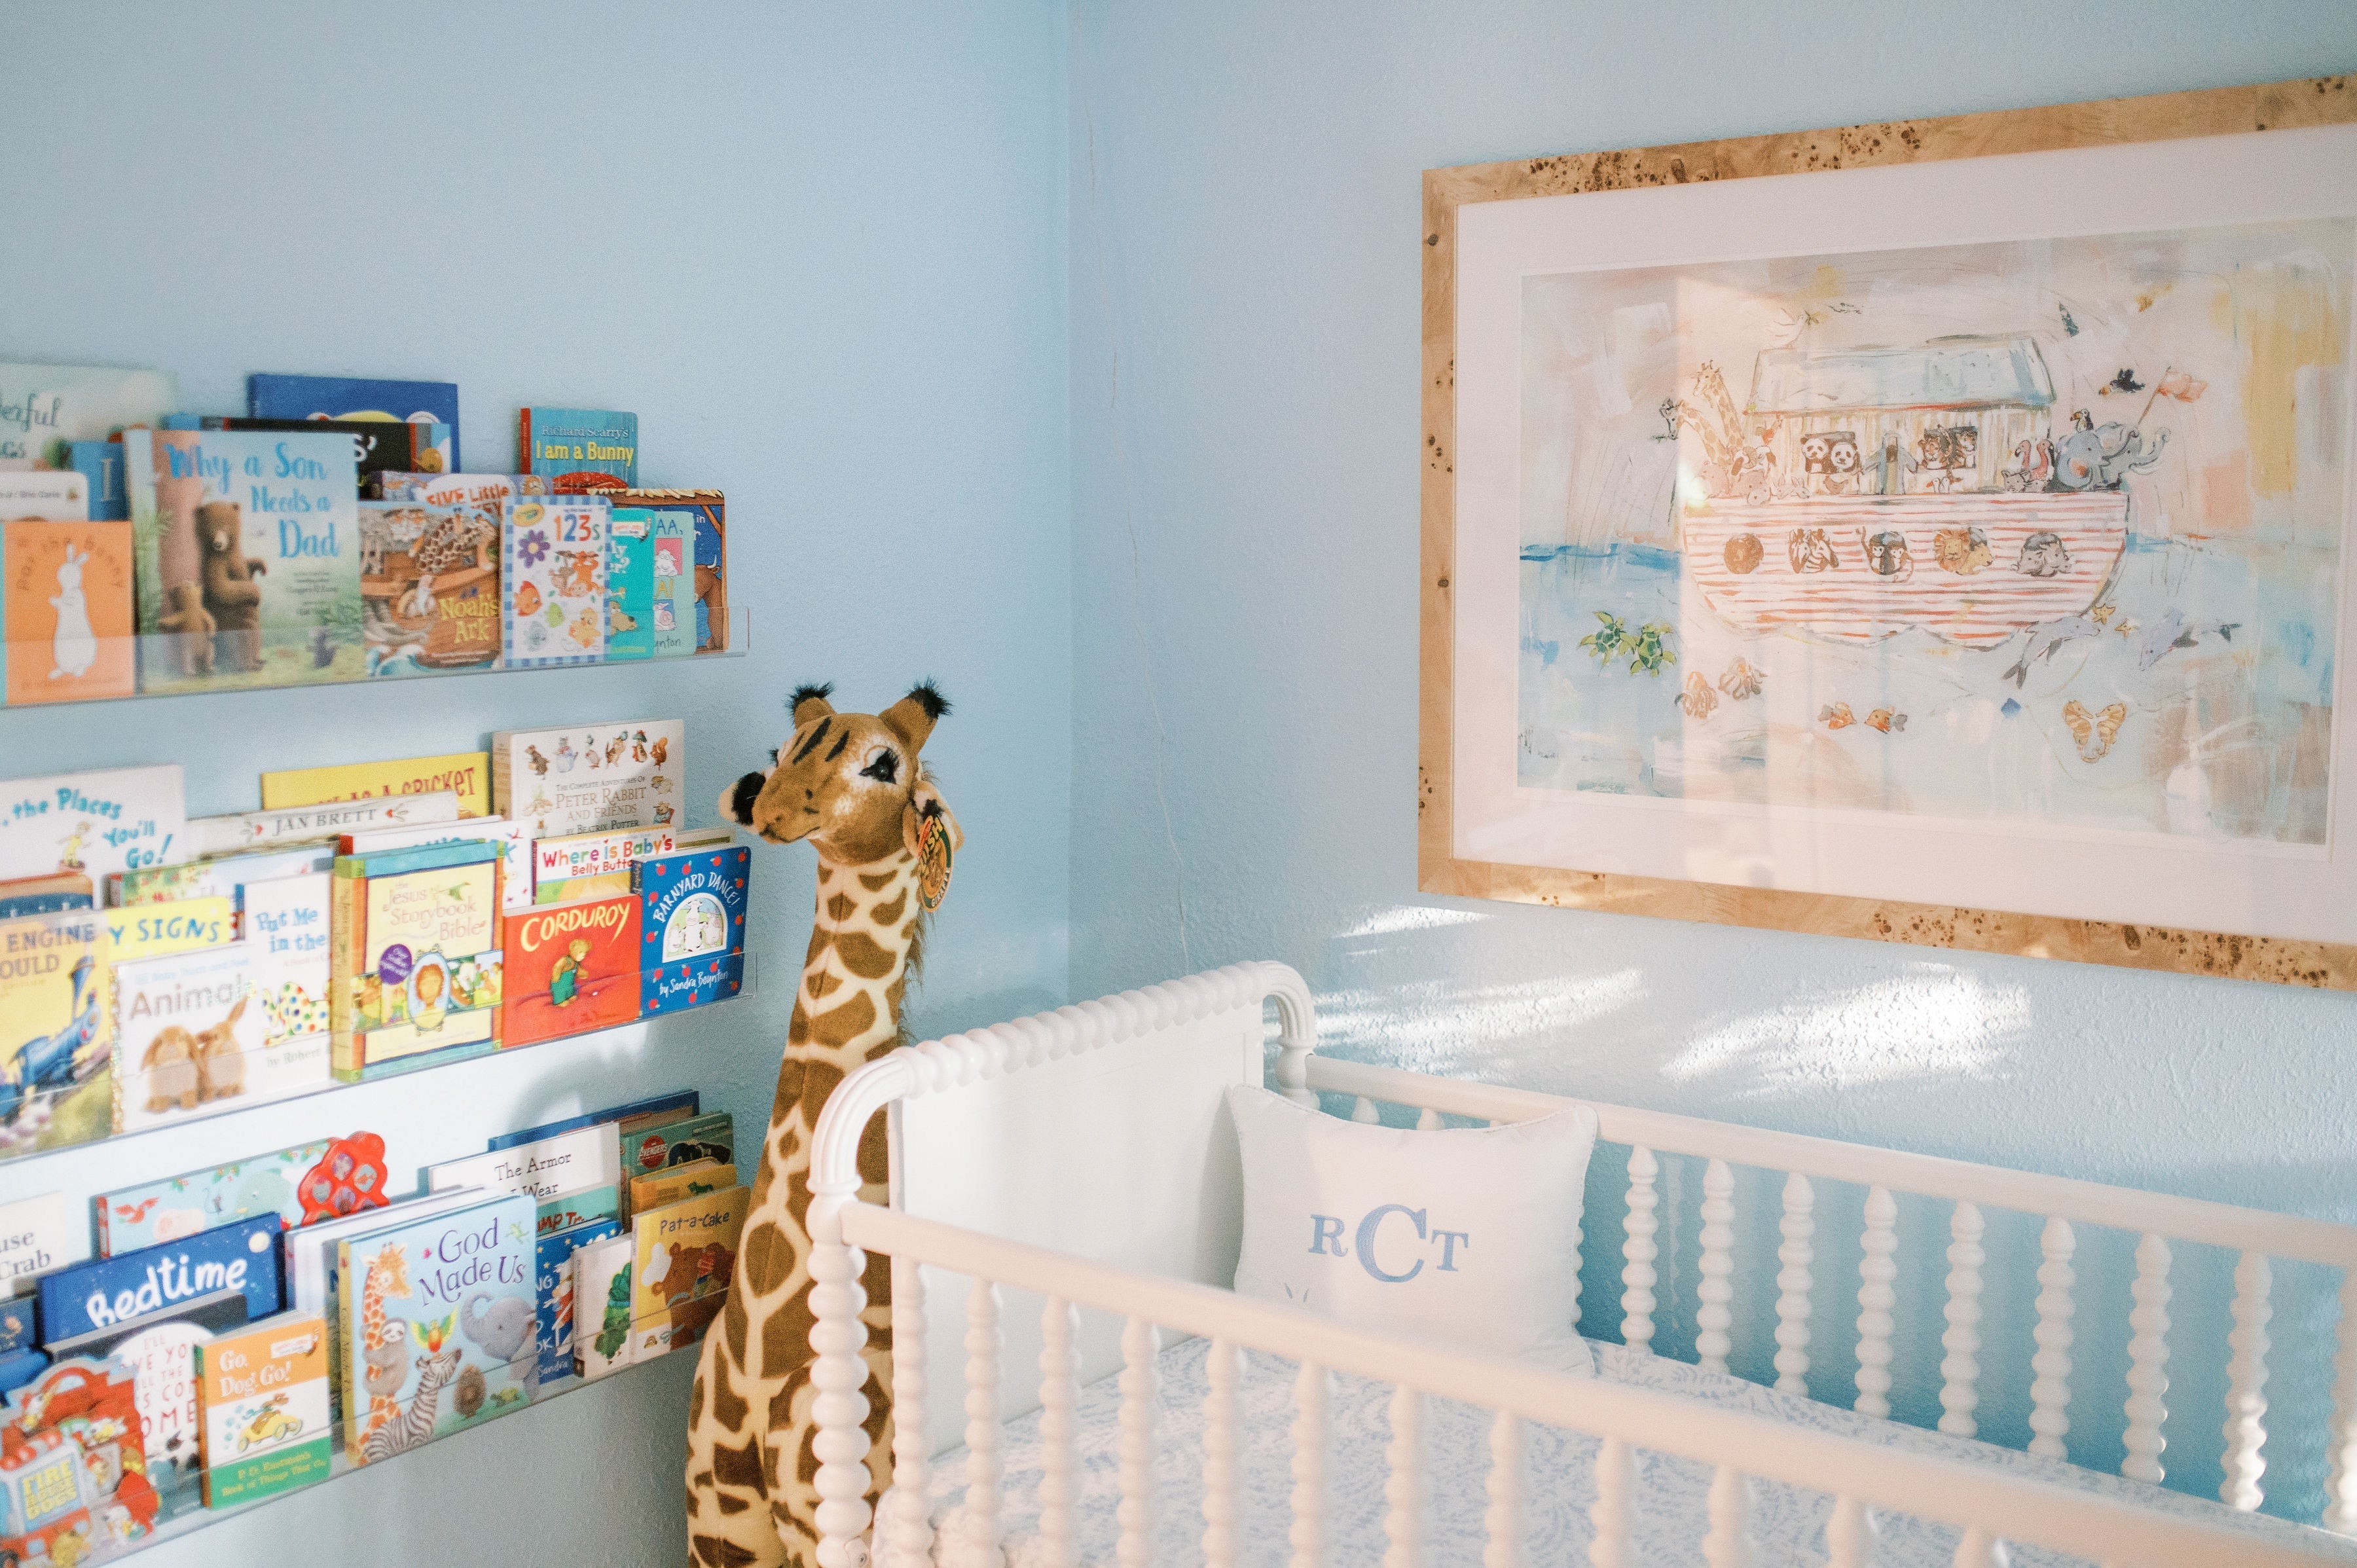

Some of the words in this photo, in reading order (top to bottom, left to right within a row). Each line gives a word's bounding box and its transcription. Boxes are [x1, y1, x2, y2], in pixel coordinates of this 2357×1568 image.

[542, 426, 585, 437] Richard
[588, 427, 629, 439] Scarry's
[536, 440, 541, 459] I
[545, 445, 569, 460] am
[574, 446, 583, 460] a
[587, 441, 634, 467] Bunny
[163, 443, 230, 494] Why
[244, 455, 261, 477] a
[274, 441, 327, 480] Son
[250, 485, 310, 513] Needs
[316, 496, 330, 511] a
[278, 519, 340, 558] Dad
[454, 619, 489, 643] Ark
[12, 799, 48, 818] the
[56, 788, 122, 820] Places
[556, 792, 598, 809] PETER
[602, 787, 647, 806] RABBIT
[272, 816, 307, 837] JAN
[316, 809, 377, 827] BRETT
[568, 811, 589, 821] AND
[594, 804, 638, 819] FRIENDS
[610, 819, 639, 830] POTTER
[101, 820, 155, 848] You'll
[126, 833, 173, 869] Go!
[543, 848, 600, 868] Where
[604, 839, 617, 860] is
[623, 833, 672, 858] Baby's
[571, 863, 598, 877] Belly
[602, 858, 633, 872] Butto
[383, 888, 427, 911] Jesus
[653, 873, 705, 923] BARNYARD
[708, 871, 740, 908] DANCE!
[255, 910, 287, 932] Put
[291, 907, 318, 926] Me
[390, 896, 477, 930] Storybook
[6, 923, 96, 953] ENGINE
[137, 916, 221, 942] SIGNS
[439, 917, 486, 941] Bible
[521, 902, 630, 953] CORDUROY
[269, 934, 289, 953] in
[295, 934, 326, 951] the
[659, 983, 669, 998] by
[670, 976, 696, 994] Sandra
[697, 968, 729, 990] Boynton
[494, 1162, 522, 1181] The
[526, 1154, 571, 1174] Armor
[522, 1182, 558, 1197] Wear
[660, 1212, 730, 1235] Pat-a-Cake
[438, 1216, 498, 1264] God
[86, 1255, 247, 1328] Bedtime
[418, 1257, 492, 1307] Made
[498, 1255, 526, 1284] Us
[166, 1344, 187, 1364] YO
[260, 1360, 292, 1385] Go!
[538, 1360, 568, 1377] Sandra
